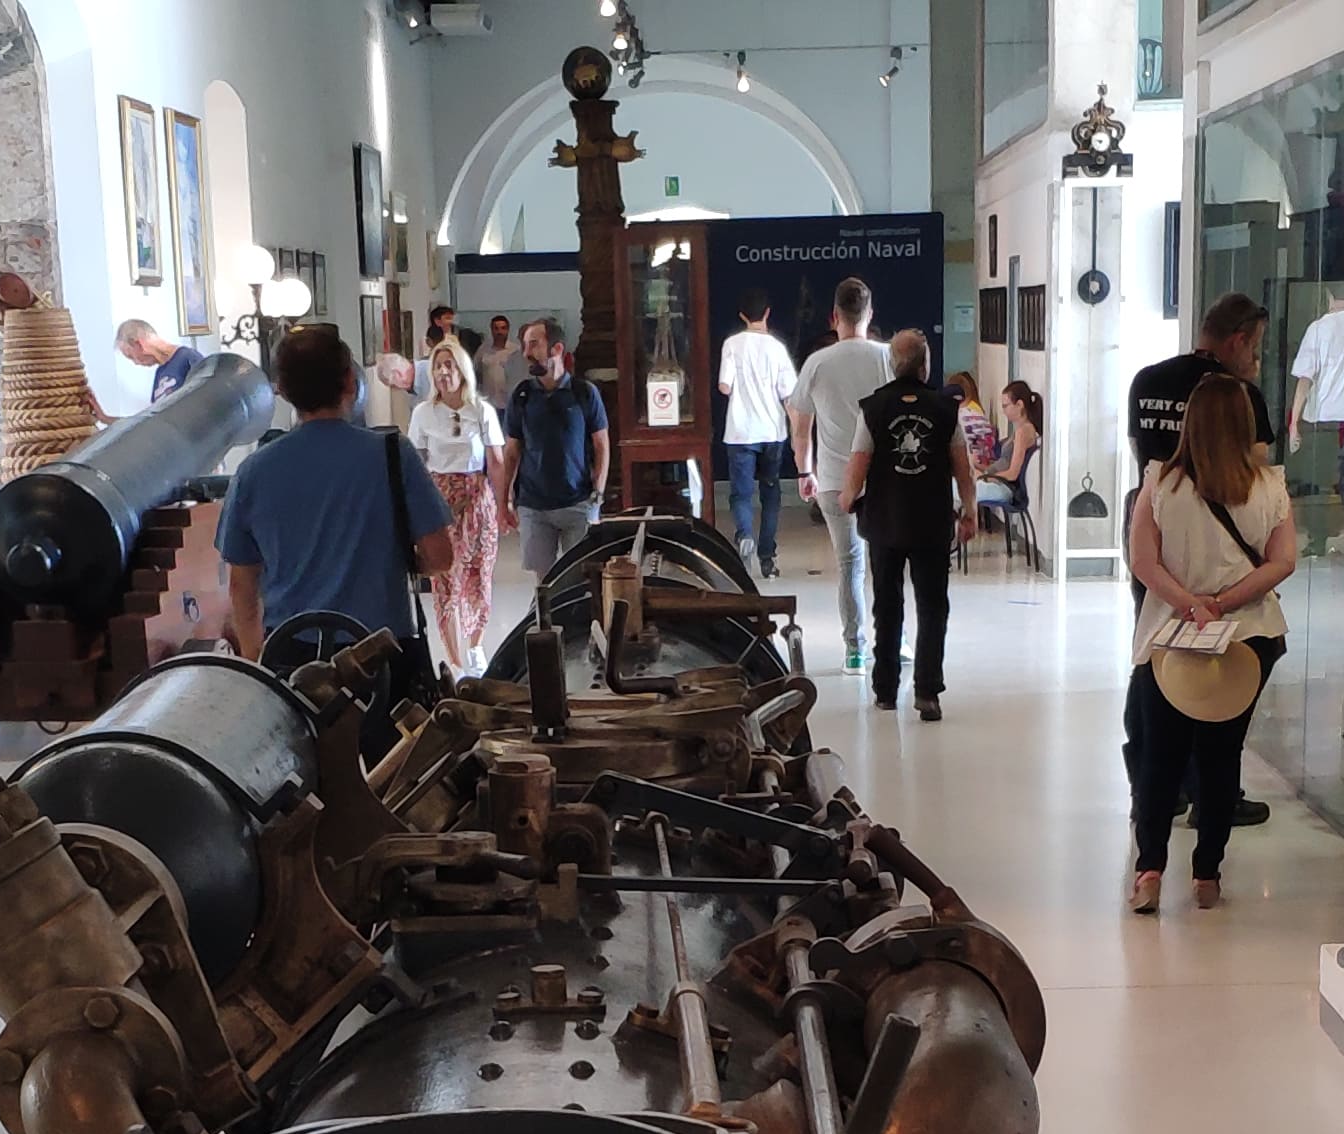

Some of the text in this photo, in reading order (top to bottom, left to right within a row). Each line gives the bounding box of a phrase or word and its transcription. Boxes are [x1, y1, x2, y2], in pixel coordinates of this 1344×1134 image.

[735, 238, 921, 263] Construcción Naval
[1139, 399, 1174, 411] VERY
[1140, 418, 1157, 430] MY
